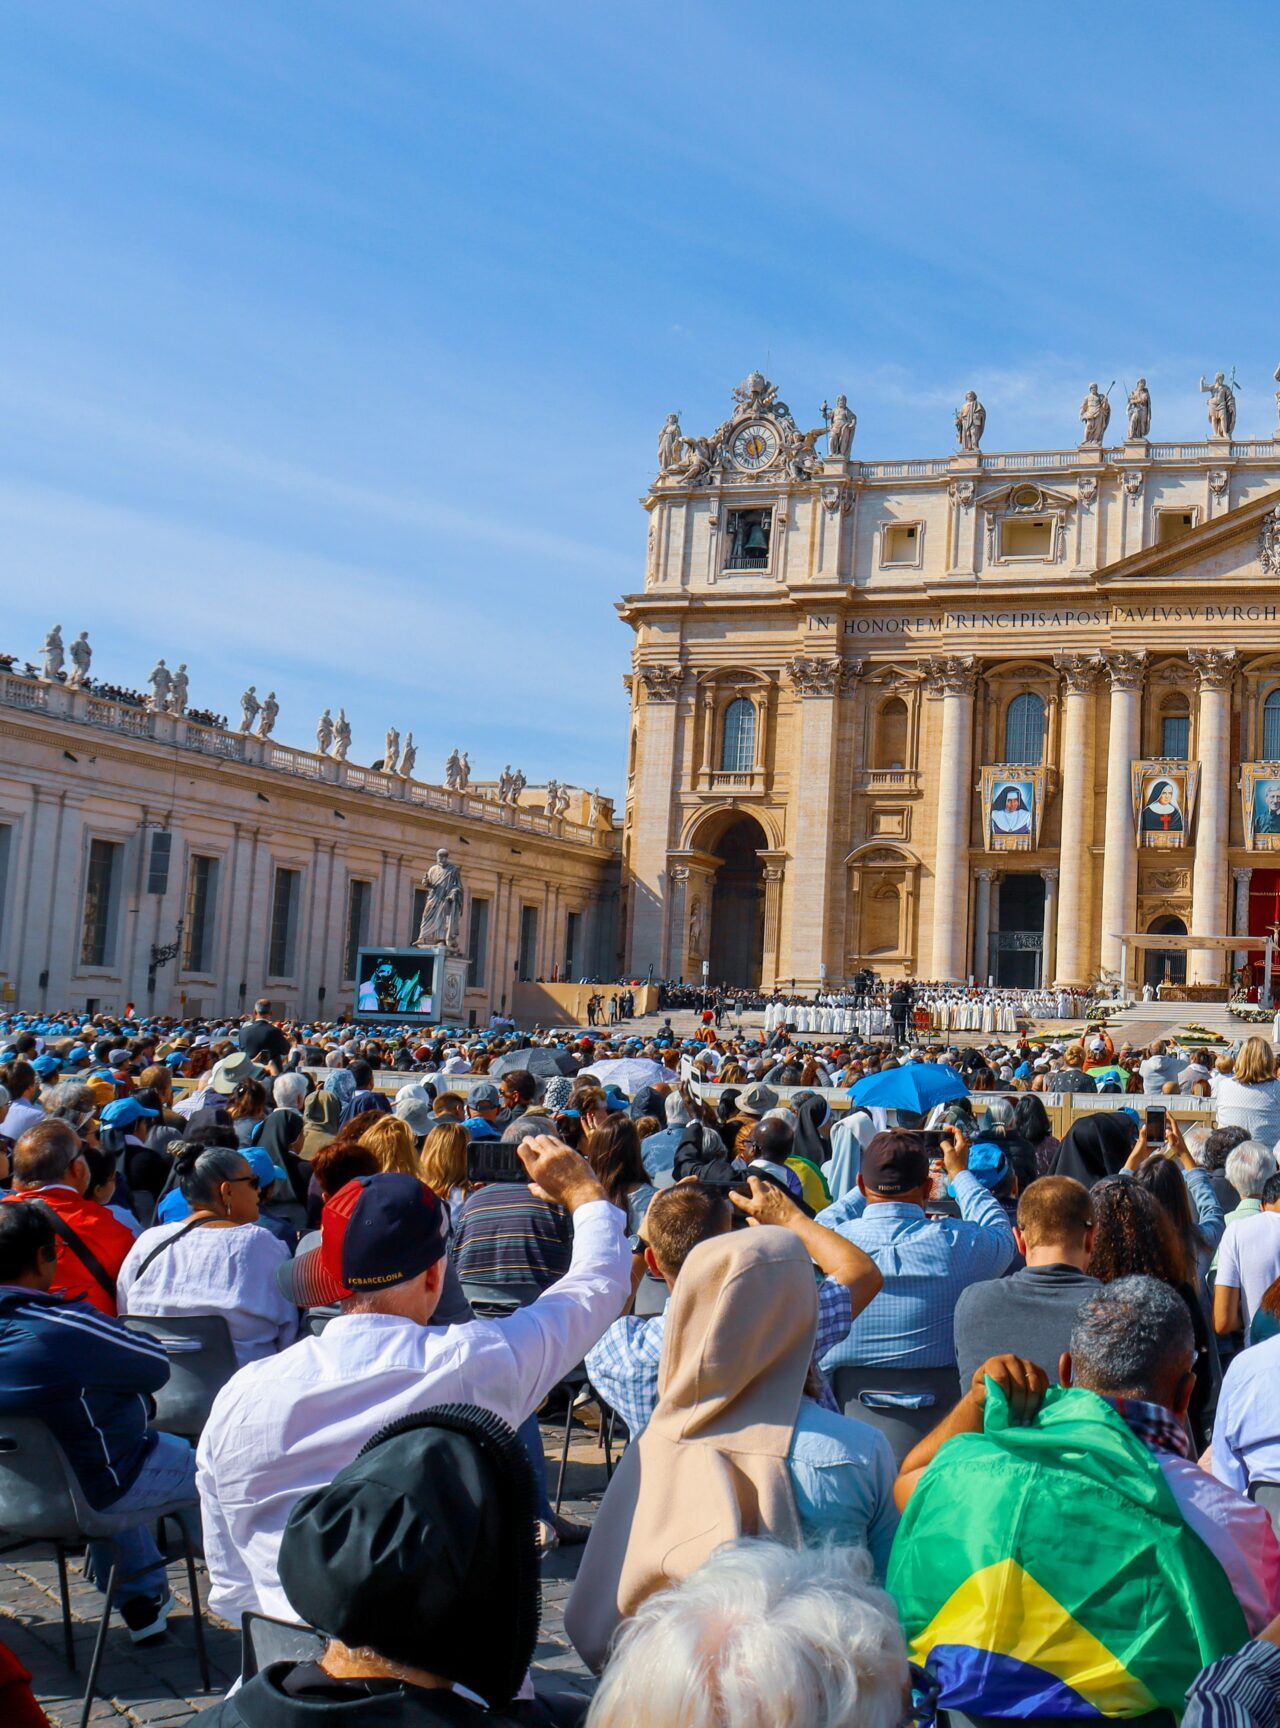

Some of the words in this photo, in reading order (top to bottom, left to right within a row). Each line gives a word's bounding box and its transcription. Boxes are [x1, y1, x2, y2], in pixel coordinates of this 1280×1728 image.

[808, 616, 830, 631] IN
[843, 618, 942, 634] HONOREM
[946, 612, 1046, 629] PRINCIPIS
[1050, 610, 1113, 626] APOST
[1114, 607, 1182, 622] PAVLVS
[1188, 606, 1200, 621] V
